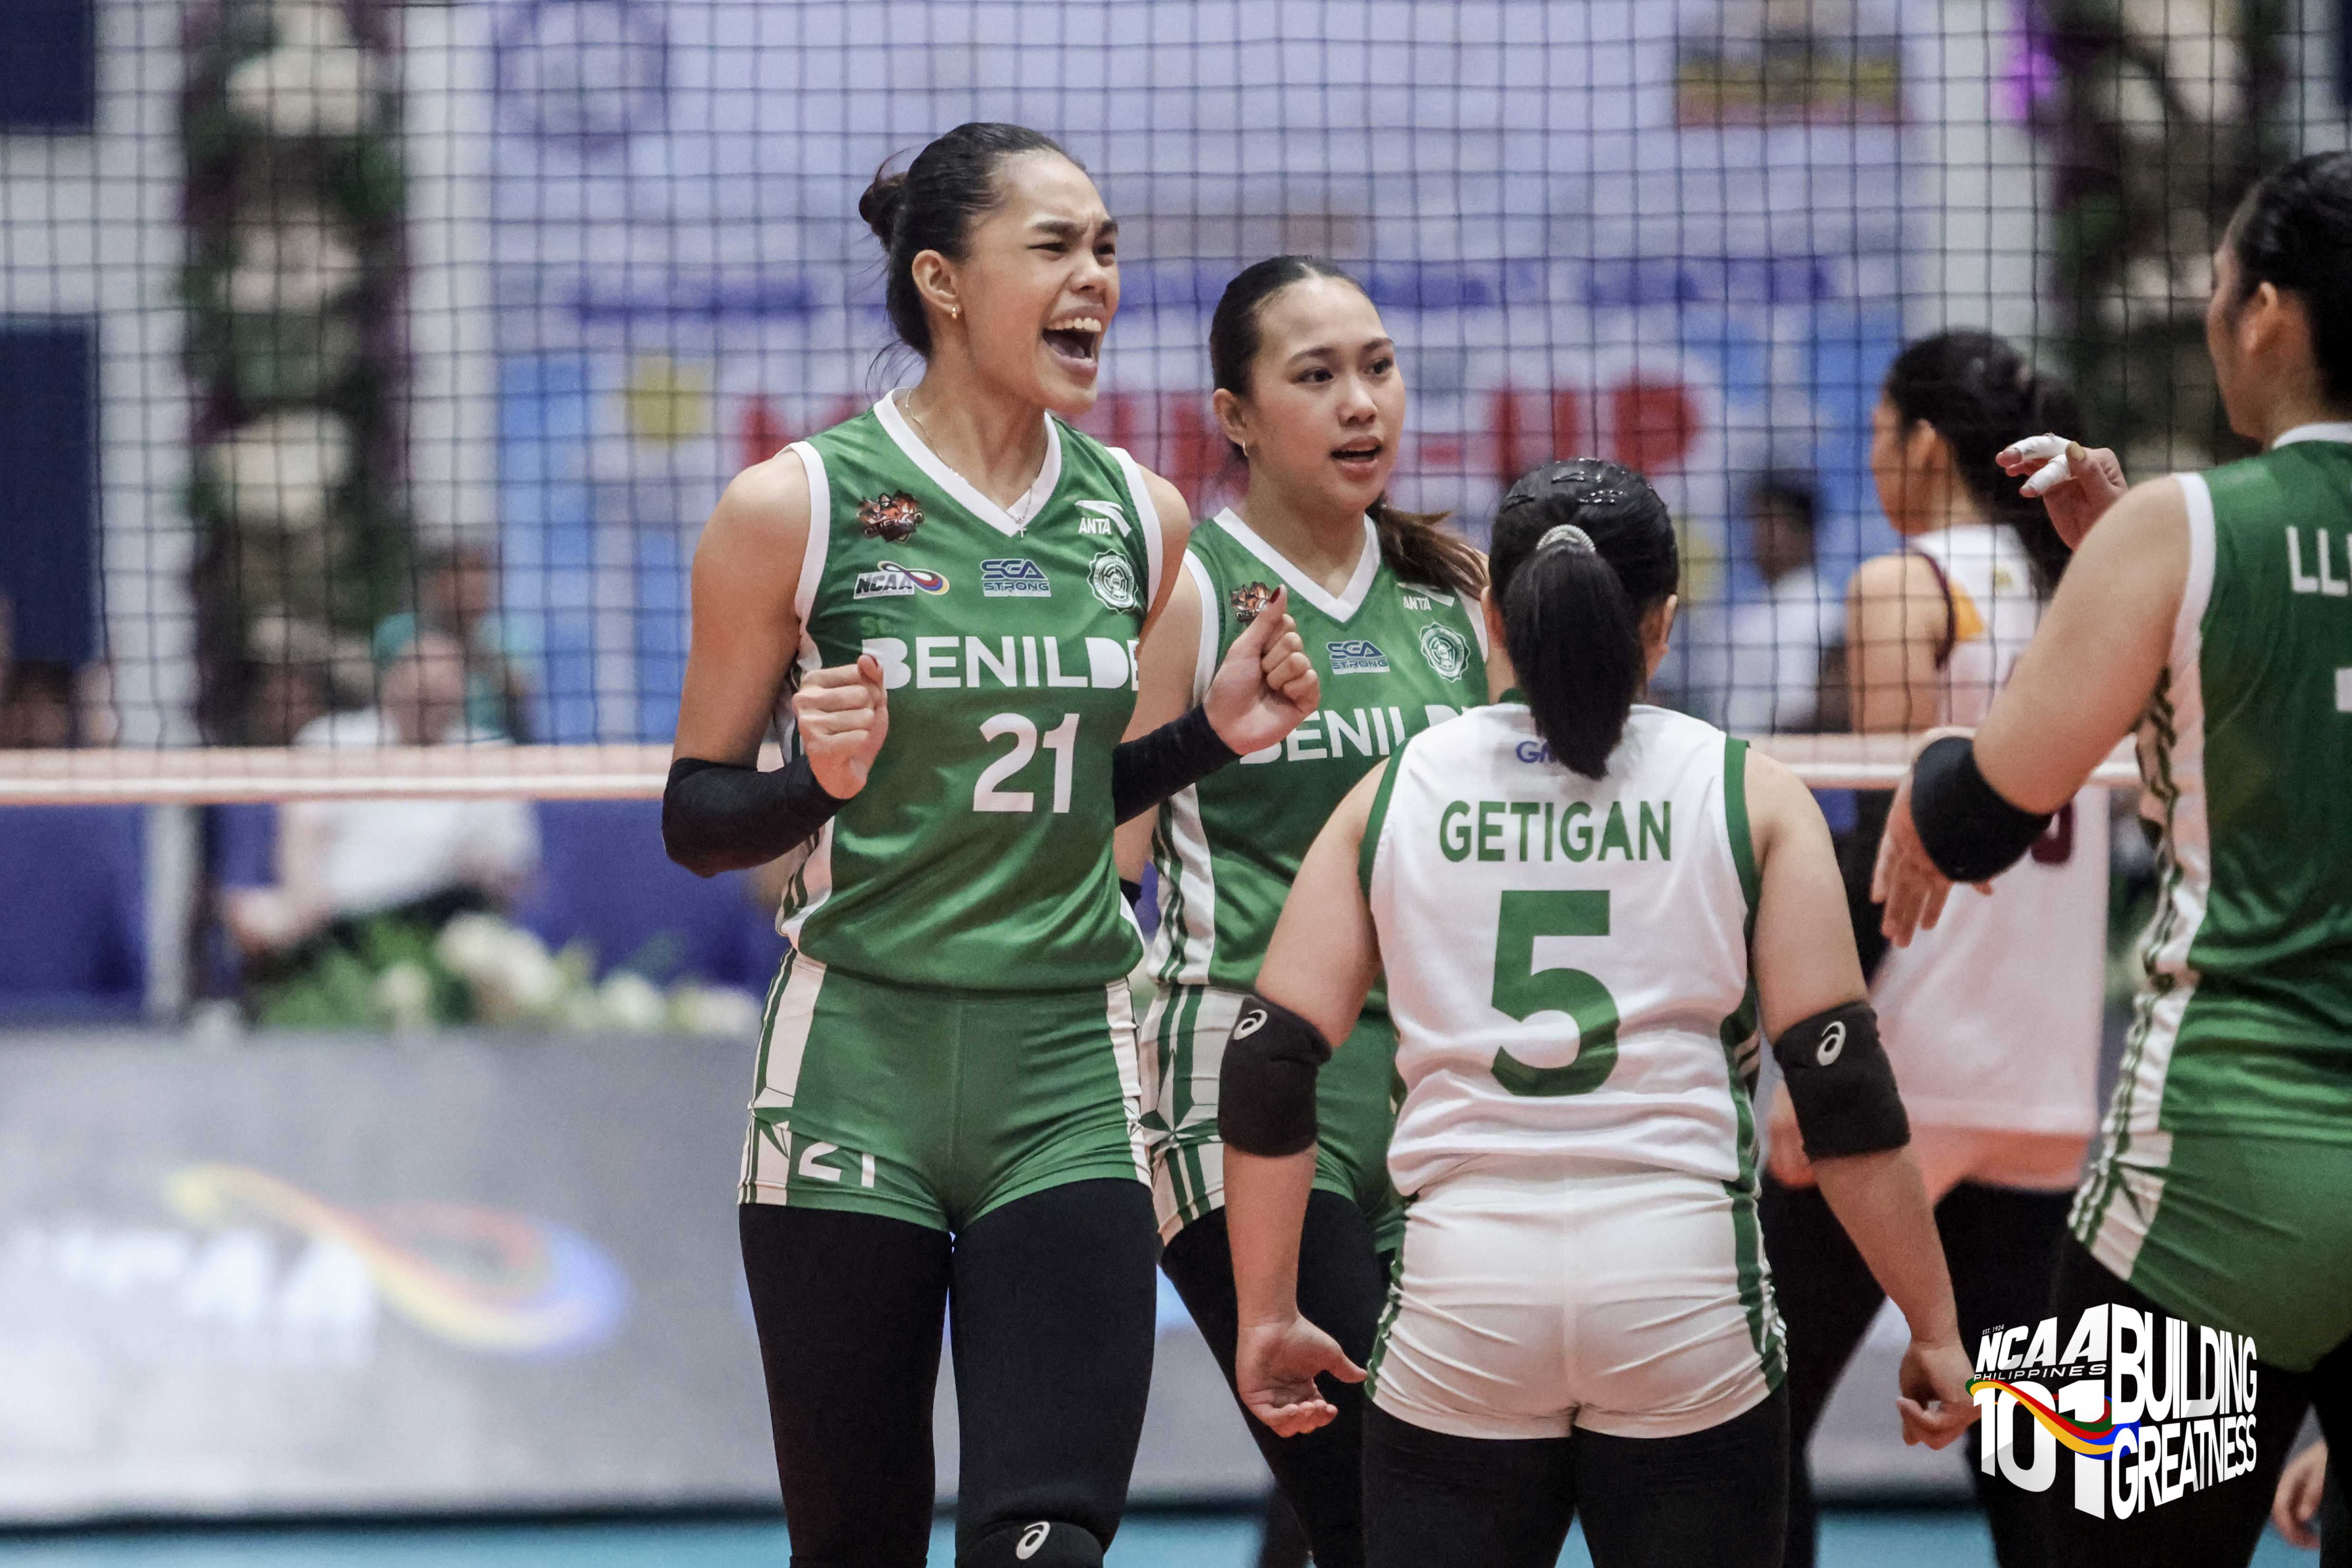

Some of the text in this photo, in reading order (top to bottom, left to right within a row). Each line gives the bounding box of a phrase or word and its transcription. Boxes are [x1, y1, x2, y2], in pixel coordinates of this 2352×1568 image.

[1078, 517, 1112, 534] ANTA
[2286, 526, 2352, 595] LL
[856, 573, 912, 593] NCAA
[984, 582, 1049, 591] STRONG
[1403, 596, 1432, 610] ANTA
[1333, 659, 1388, 669] STRONG
[973, 713, 1080, 813] 21
[1439, 800, 1672, 862] GETIGAN
[1491, 890, 1620, 1097] 5
